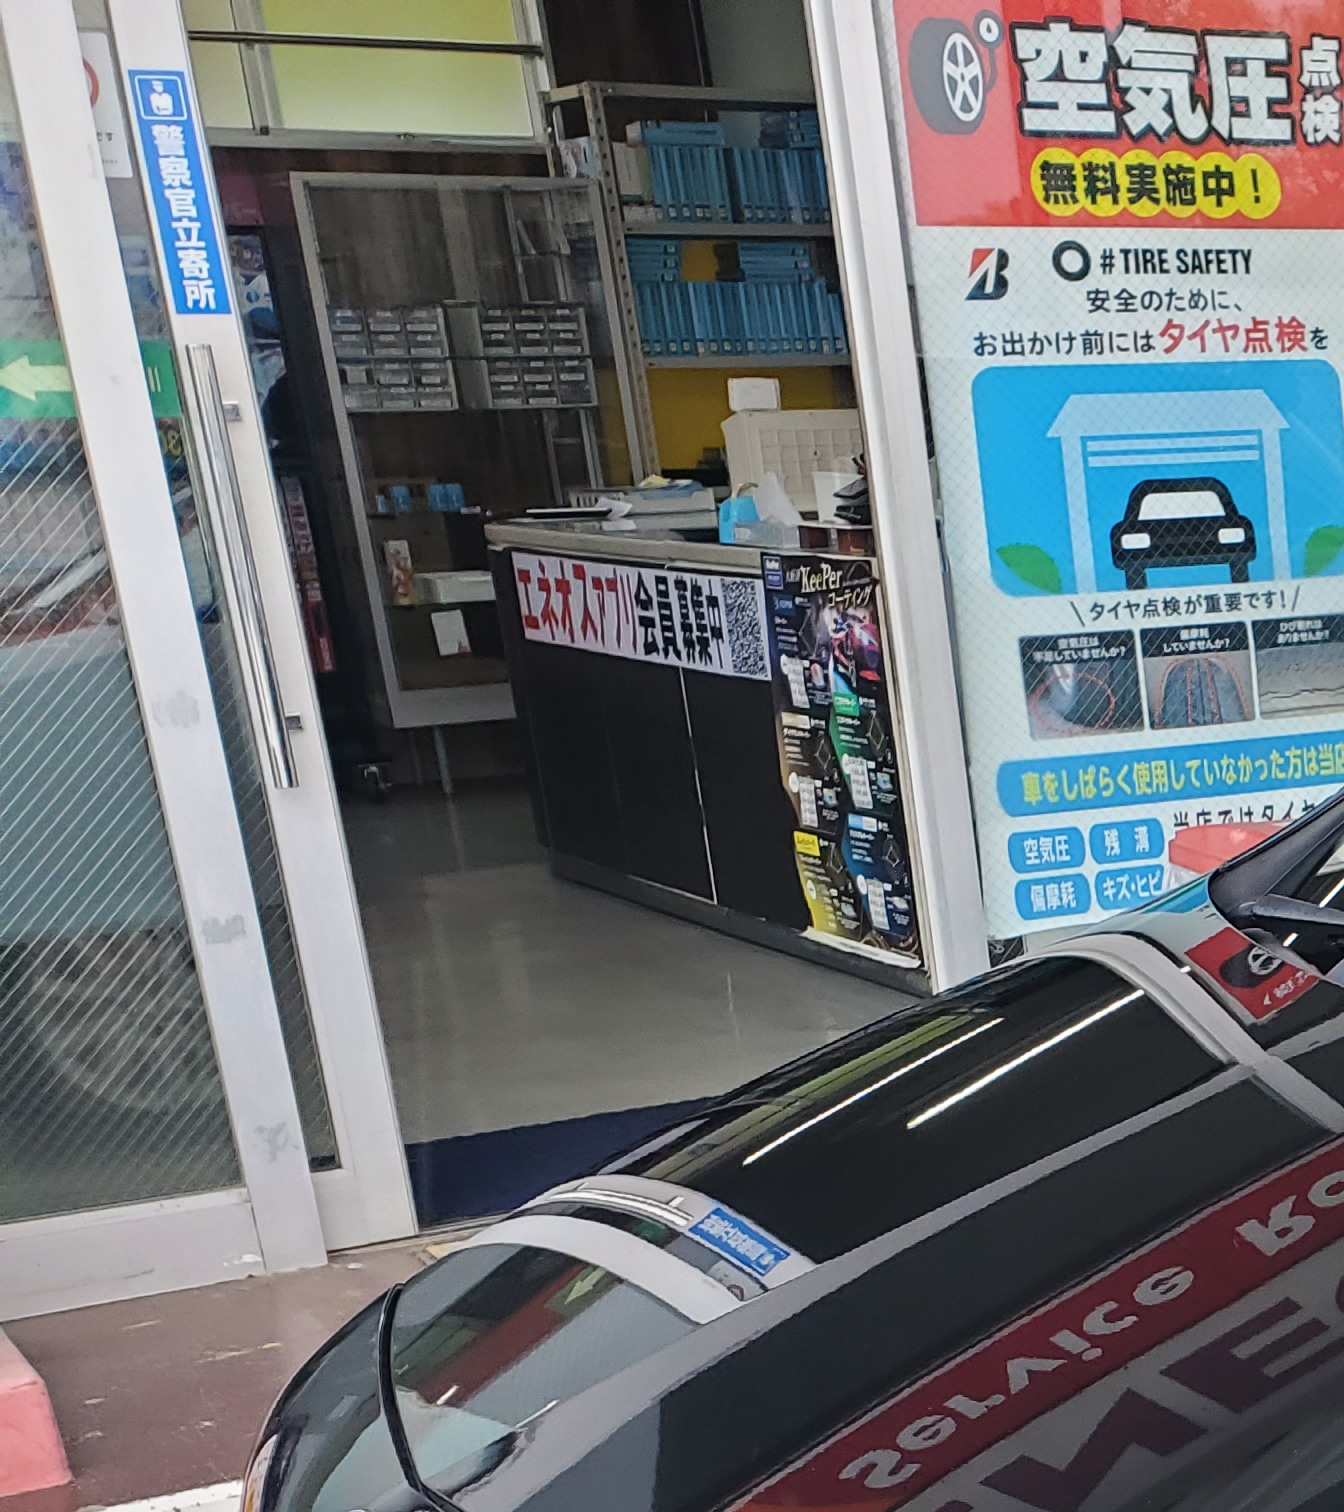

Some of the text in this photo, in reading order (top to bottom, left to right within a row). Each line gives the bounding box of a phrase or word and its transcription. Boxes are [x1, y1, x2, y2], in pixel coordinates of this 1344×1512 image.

[1013, 21, 1343, 146] 空気圧 点検
[151, 124, 217, 310] 警察官立寄所
[1177, 248, 1252, 276] SAFETY
[800, 562, 843, 593] KeePer
[1023, 834, 1071, 865] 空気圧
[1031, 883, 1076, 913] 偏摩耗
